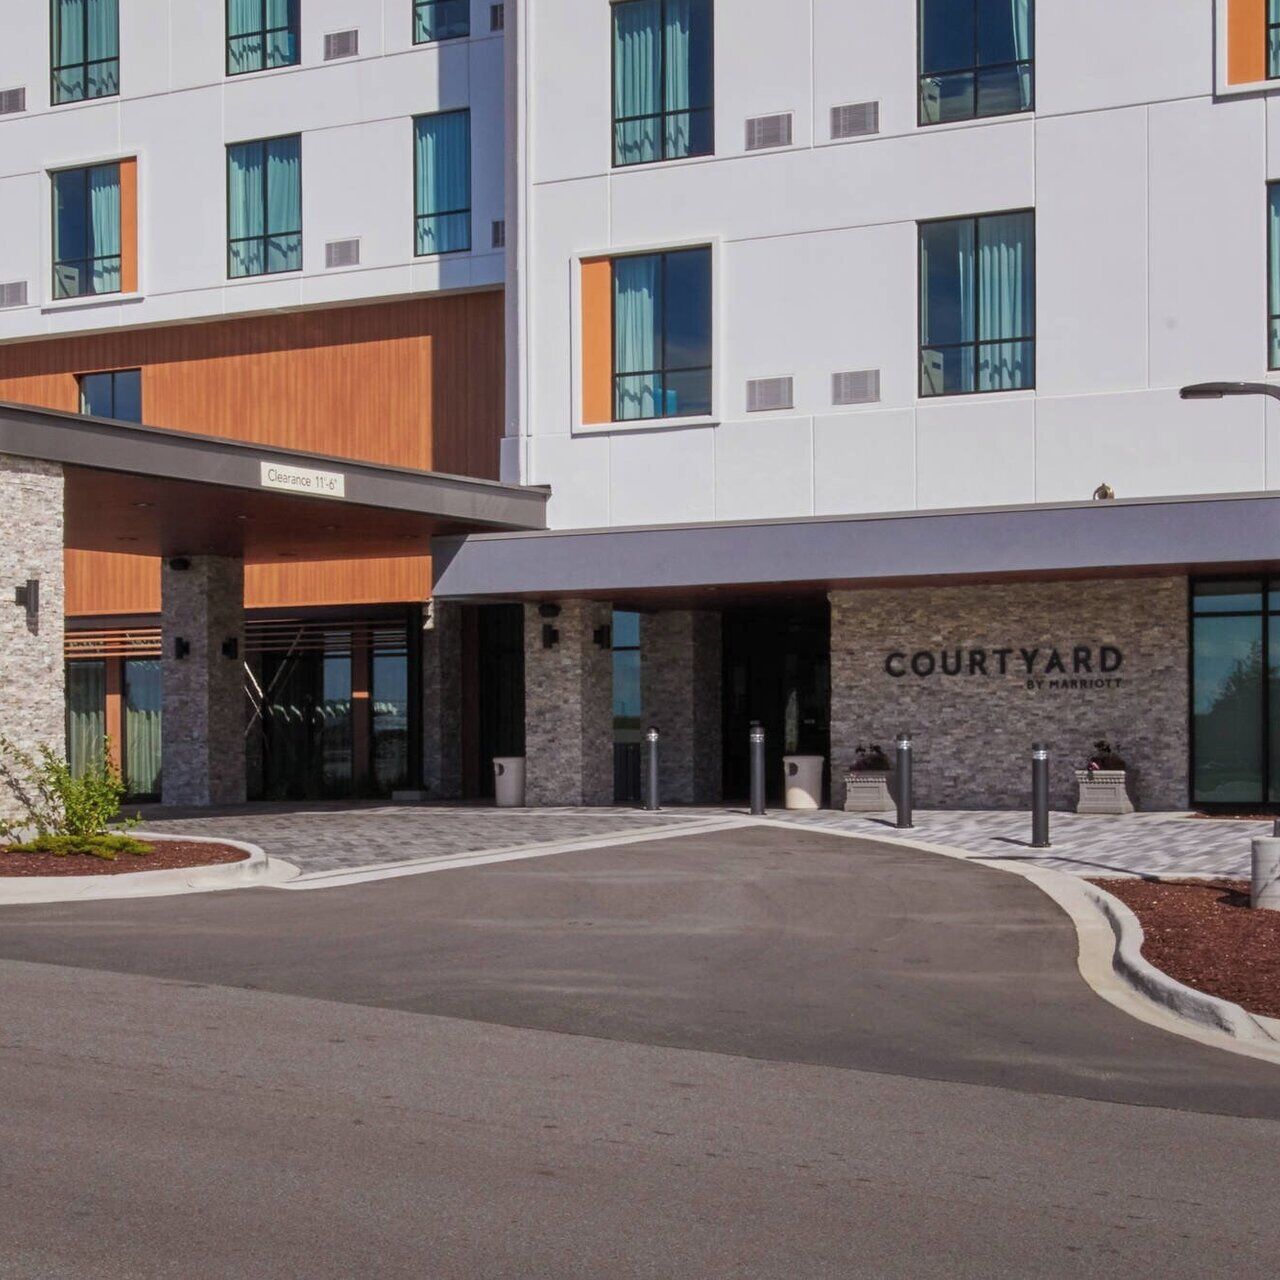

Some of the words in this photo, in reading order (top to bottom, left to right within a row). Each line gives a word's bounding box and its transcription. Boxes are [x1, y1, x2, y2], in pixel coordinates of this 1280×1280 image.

[267, 468, 311, 487] Clearance
[884, 645, 1124, 679] COURTYARD
[1026, 679, 1044, 690] BY
[1049, 678, 1122, 689] MARRIOTT
